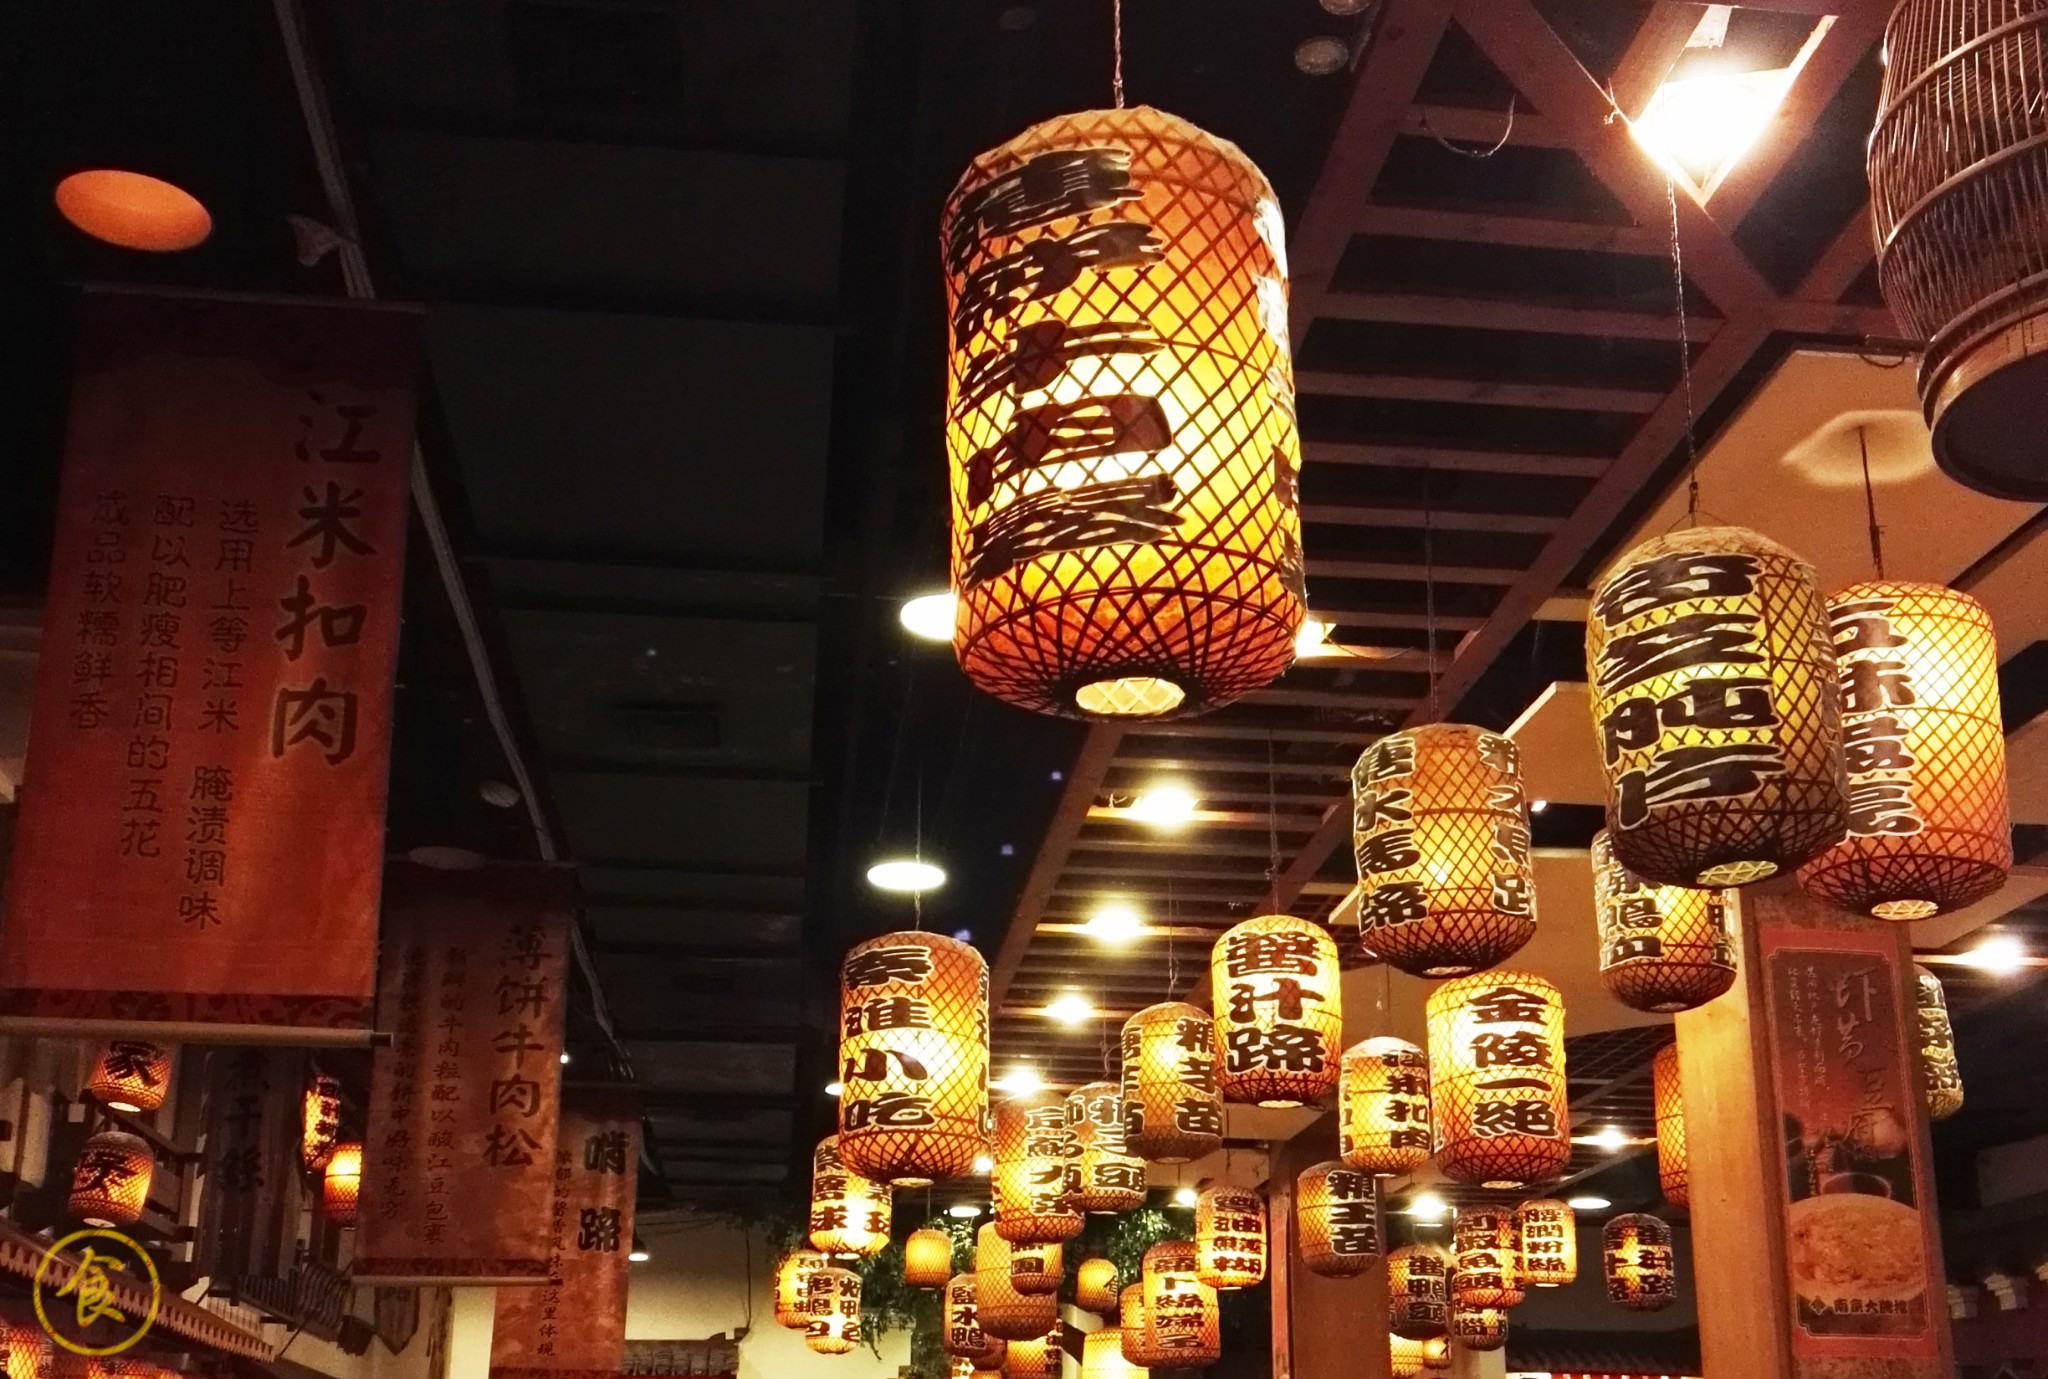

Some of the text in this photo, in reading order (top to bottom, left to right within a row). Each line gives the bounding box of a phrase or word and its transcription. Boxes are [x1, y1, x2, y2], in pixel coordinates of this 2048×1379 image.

[68, 492, 130, 731] 成品软糯鲜香
[120, 494, 195, 859] 配以肥瘦相间的五花
[270, 391, 381, 767] 江米扣肉
[177, 498, 259, 930] 选用上等江米 腌渍调味
[482, 925, 552, 1168] 薄饼牛肉松
[842, 946, 935, 1131] 秦淮小吃
[1466, 987, 1558, 1137] 金陵一絕
